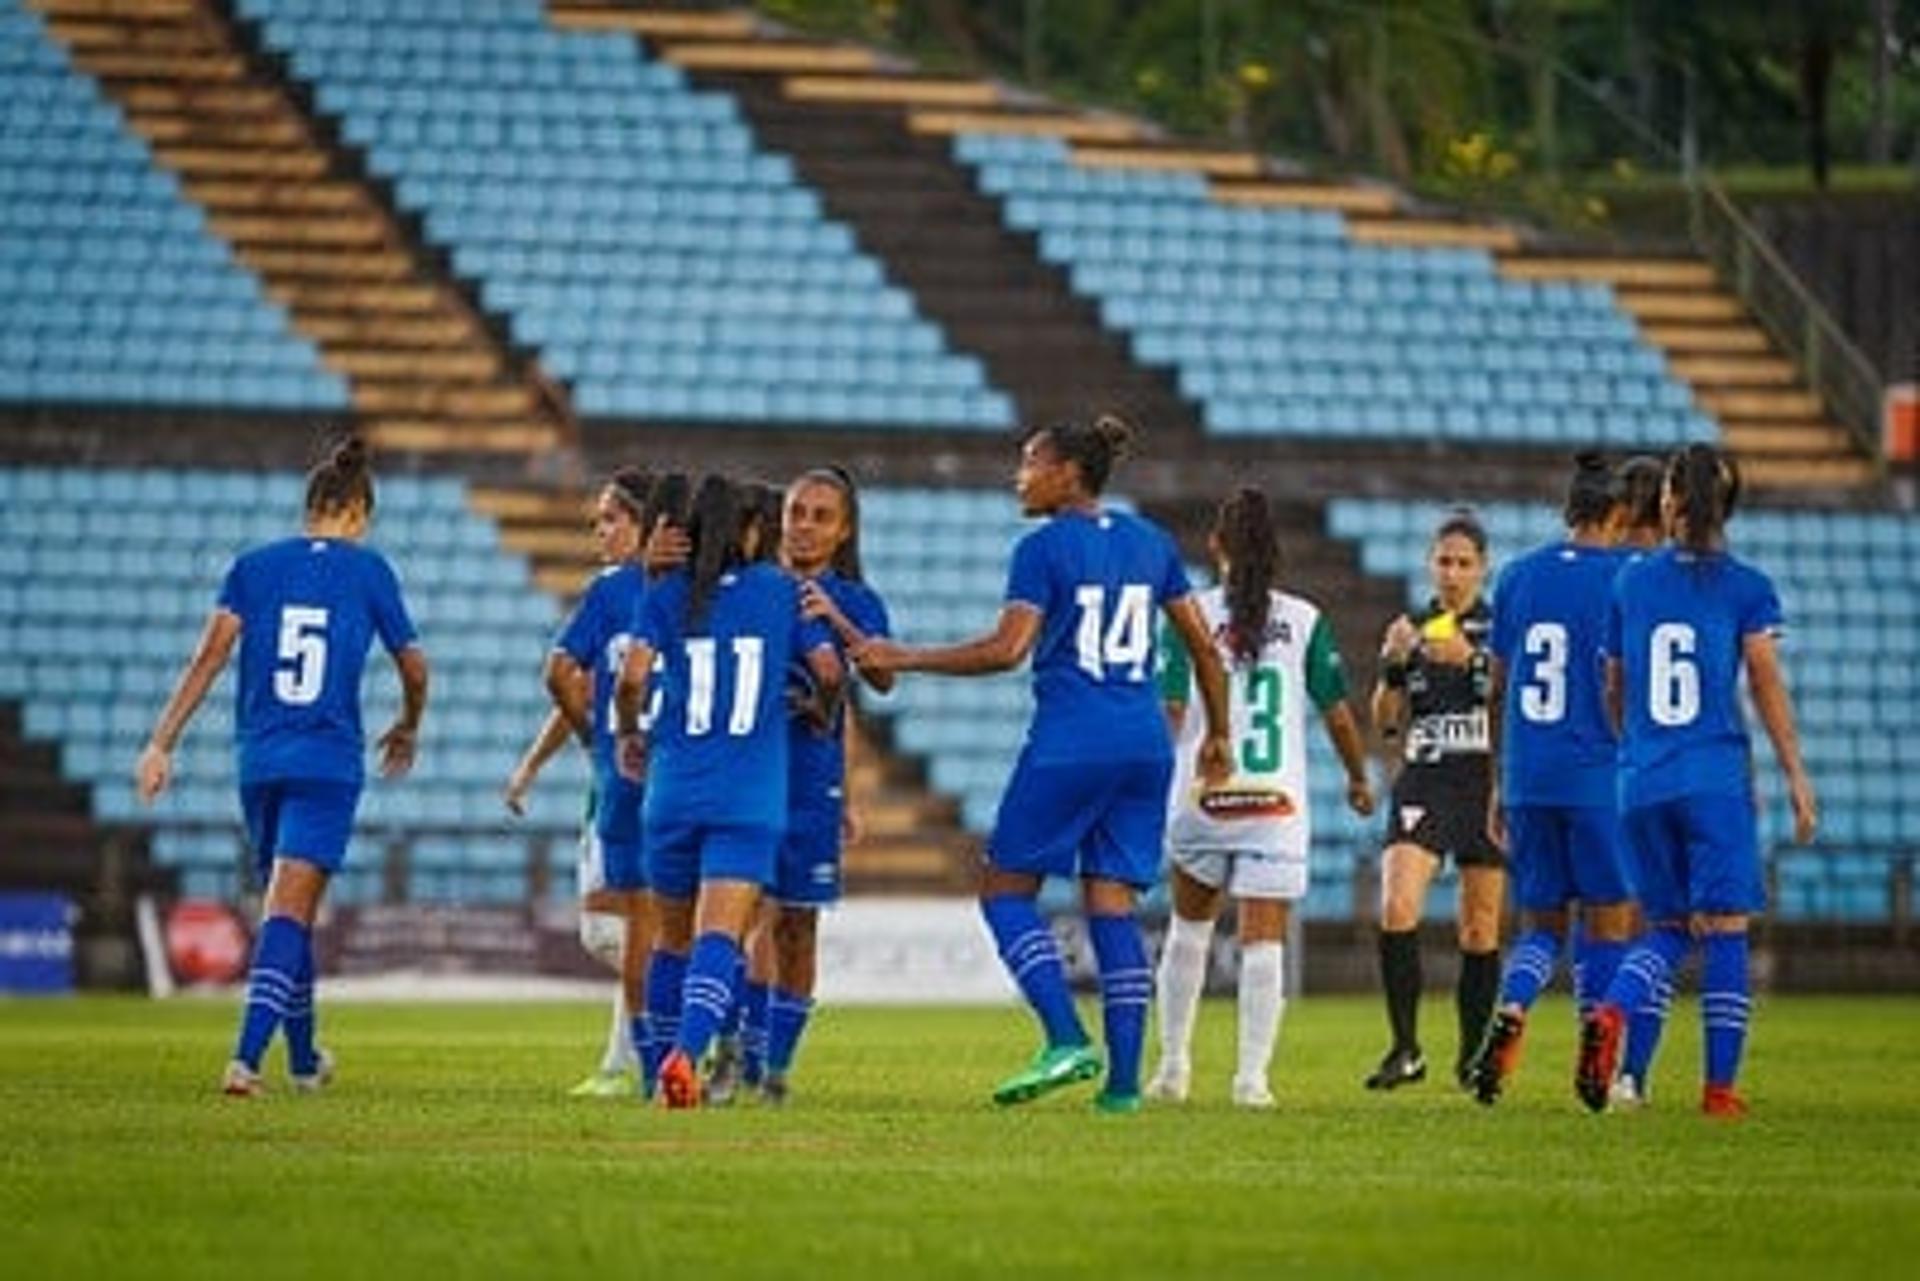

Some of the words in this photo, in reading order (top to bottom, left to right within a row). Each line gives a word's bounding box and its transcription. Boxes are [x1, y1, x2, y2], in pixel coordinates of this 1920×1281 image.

[274, 605, 329, 705] 5
[1075, 584, 1152, 681] 14
[1520, 622, 1568, 723] 3
[1649, 622, 1700, 726] 6
[685, 637, 764, 735] 11
[1242, 665, 1282, 774] 3
